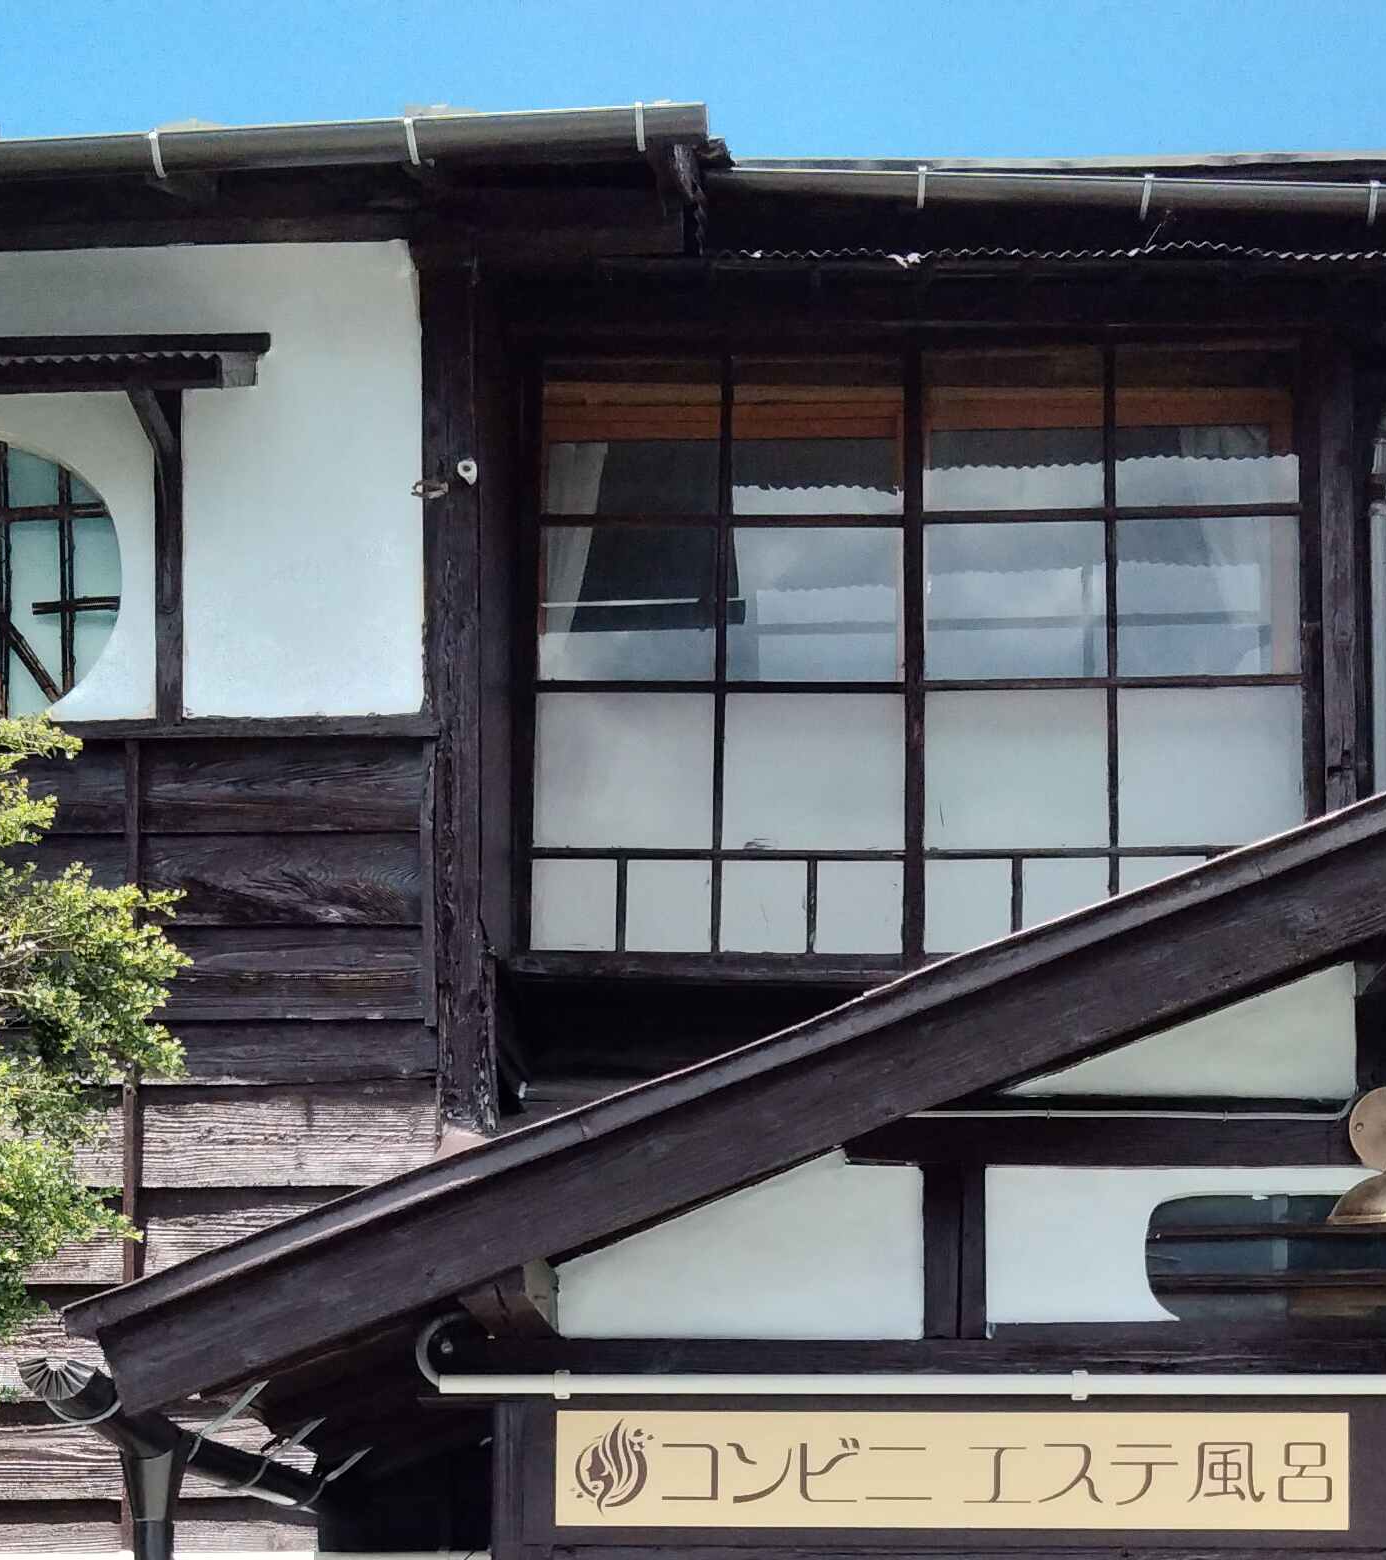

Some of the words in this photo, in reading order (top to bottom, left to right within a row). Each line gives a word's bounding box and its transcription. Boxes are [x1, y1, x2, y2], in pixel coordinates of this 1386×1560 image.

[661, 1437, 932, 1504] コンビニ
[963, 1441, 1333, 1506] エステ風呂
